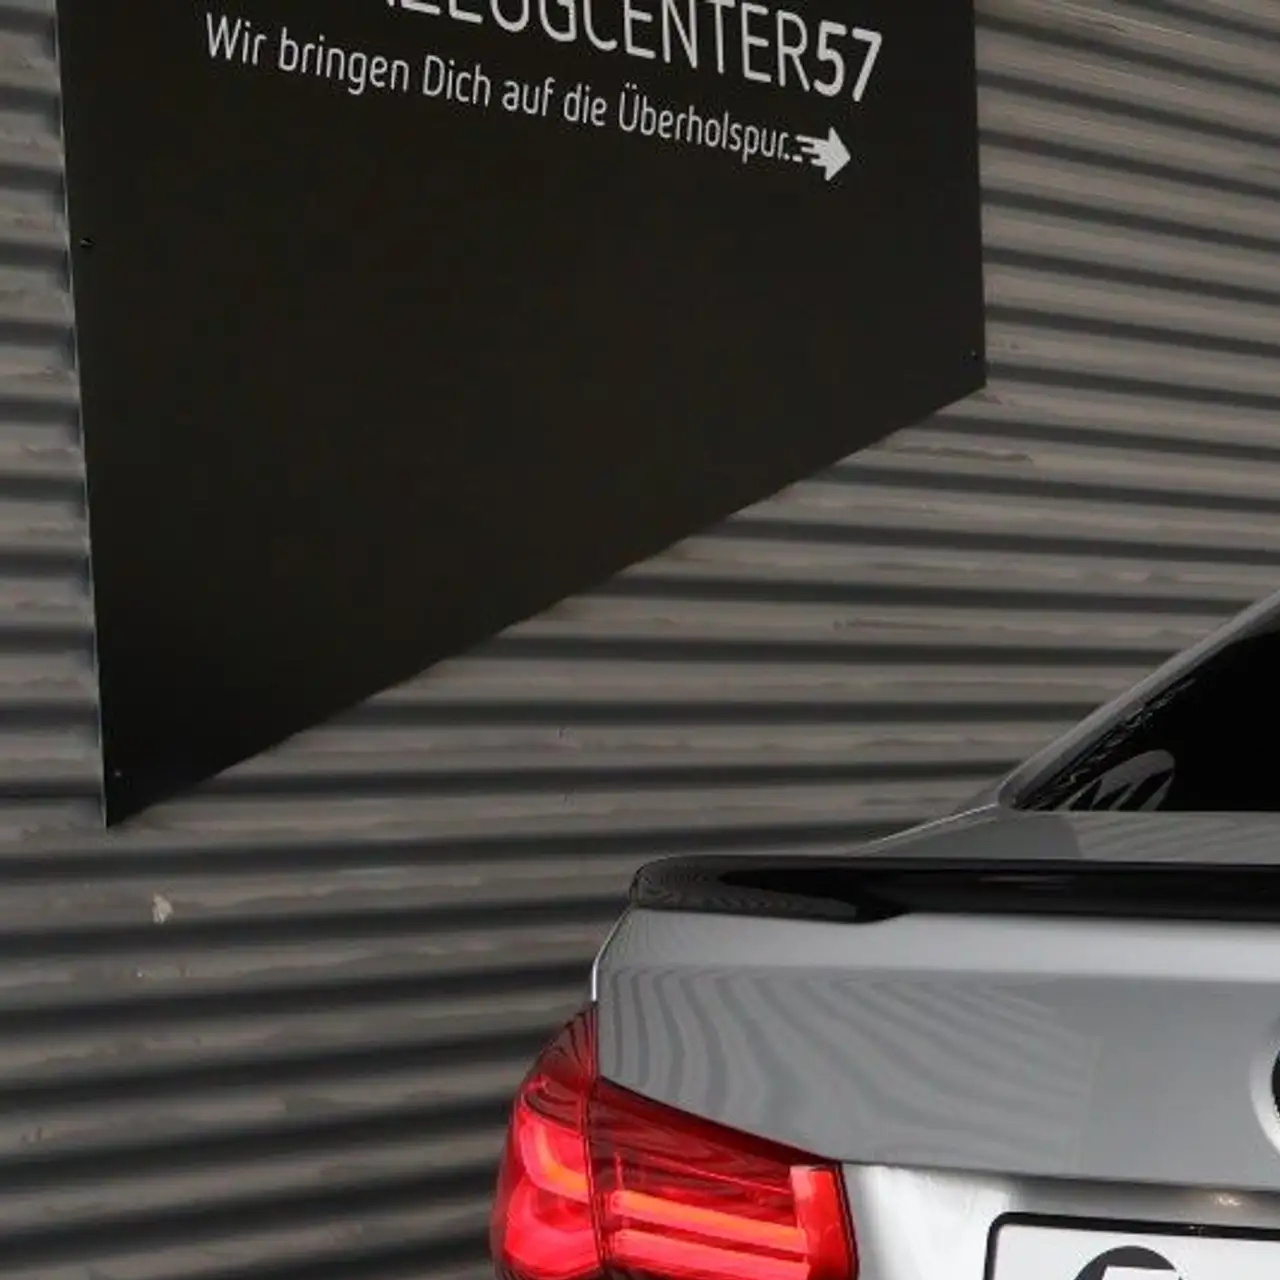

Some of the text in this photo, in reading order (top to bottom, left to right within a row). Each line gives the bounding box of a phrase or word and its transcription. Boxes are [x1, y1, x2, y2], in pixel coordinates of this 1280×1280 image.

[205, 12, 267, 66] Wir
[278, 26, 410, 95] bringen
[422, 54, 492, 107] Dich
[501, 77, 556, 117] auf
[563, 82, 608, 127] die
